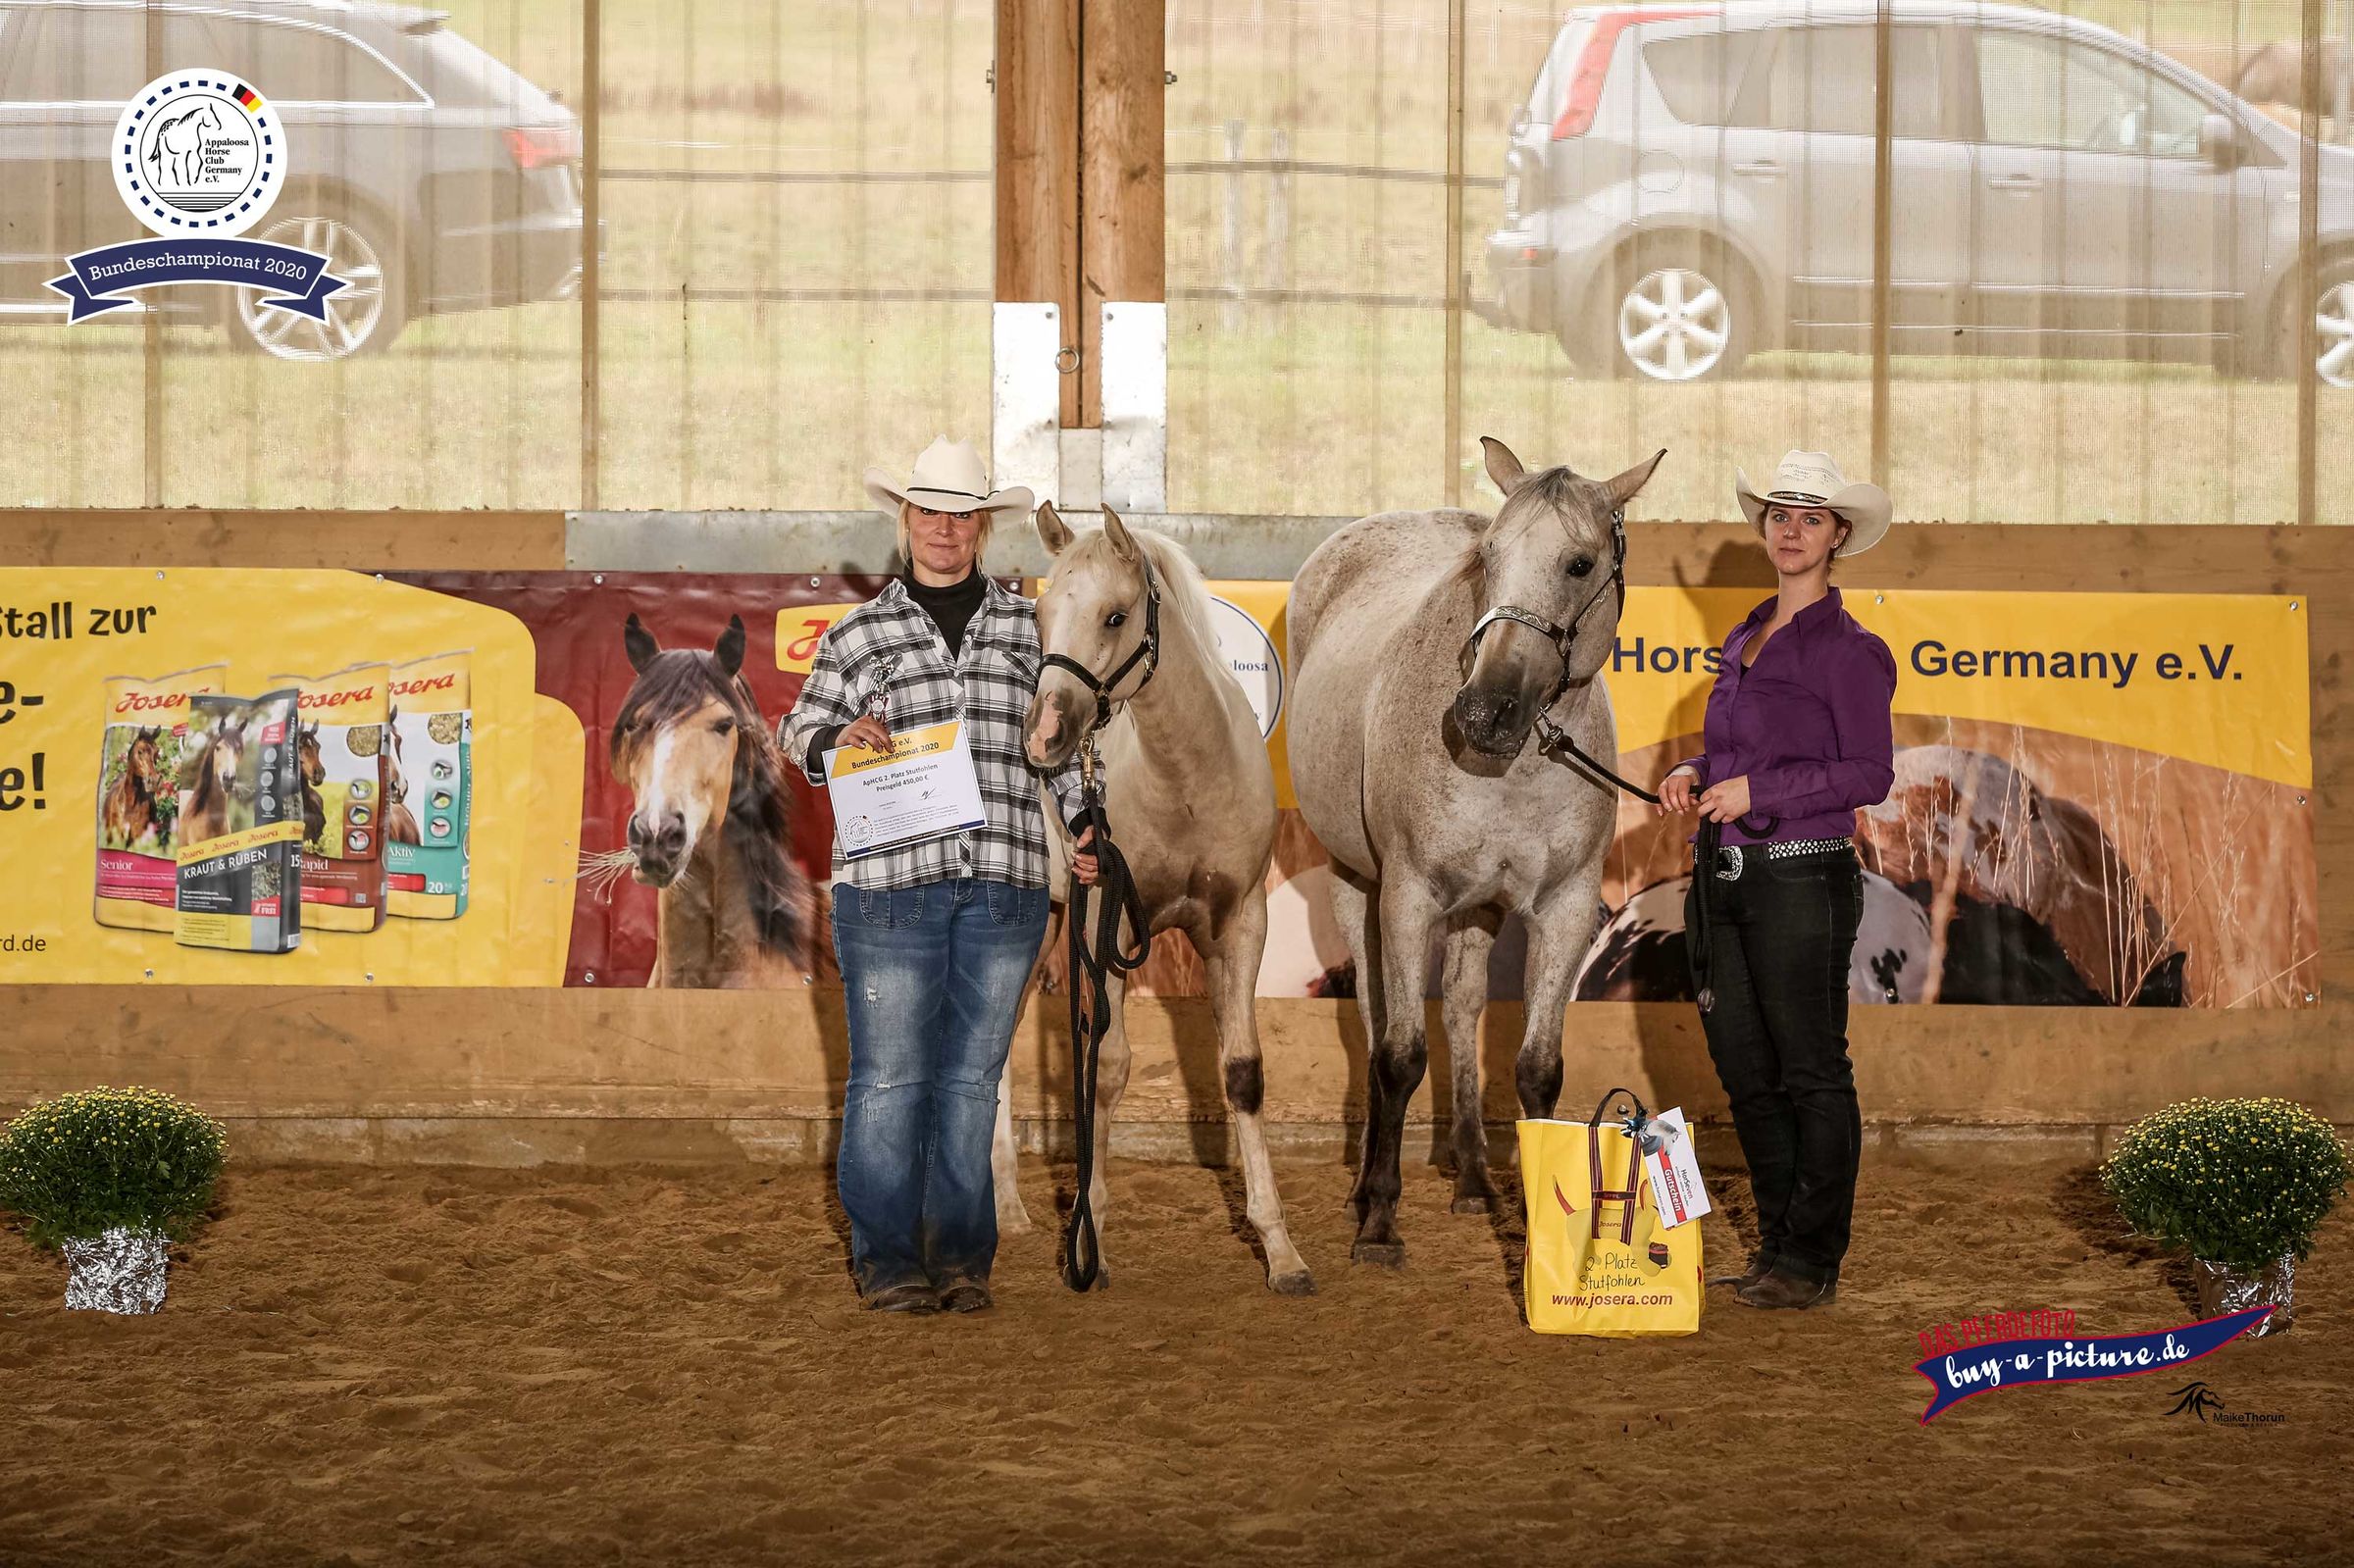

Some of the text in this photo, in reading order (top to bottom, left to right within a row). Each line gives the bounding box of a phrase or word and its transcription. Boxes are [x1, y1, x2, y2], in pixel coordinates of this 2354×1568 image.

[0, 601, 157, 639] tall zur
[1233, 660, 1268, 672] loosa
[1613, 636, 2242, 688] Hors Germany e.V.
[116, 687, 209, 713] Joser
[298, 685, 375, 709] osera
[898, 736, 912, 746] e.V.
[851, 741, 940, 769] Bundeschampionat 2020
[891, 771, 904, 780] Platz
[905, 763, 939, 776] Stutfohlen
[876, 782, 902, 792] Preisgeld
[902, 776, 924, 786] 450,00
[101, 859, 133, 871] Senior
[183, 862, 215, 880] KRAUT
[218, 859, 226, 870] &
[301, 859, 329, 872] apid
[428, 882, 444, 893] 20
[1663, 1168, 1682, 1212] Gutschein
[1605, 1251, 1639, 1270] Platz
[1578, 1274, 1646, 1292] Stutfohlen
[1552, 1292, 1673, 1309] www.josera.com
